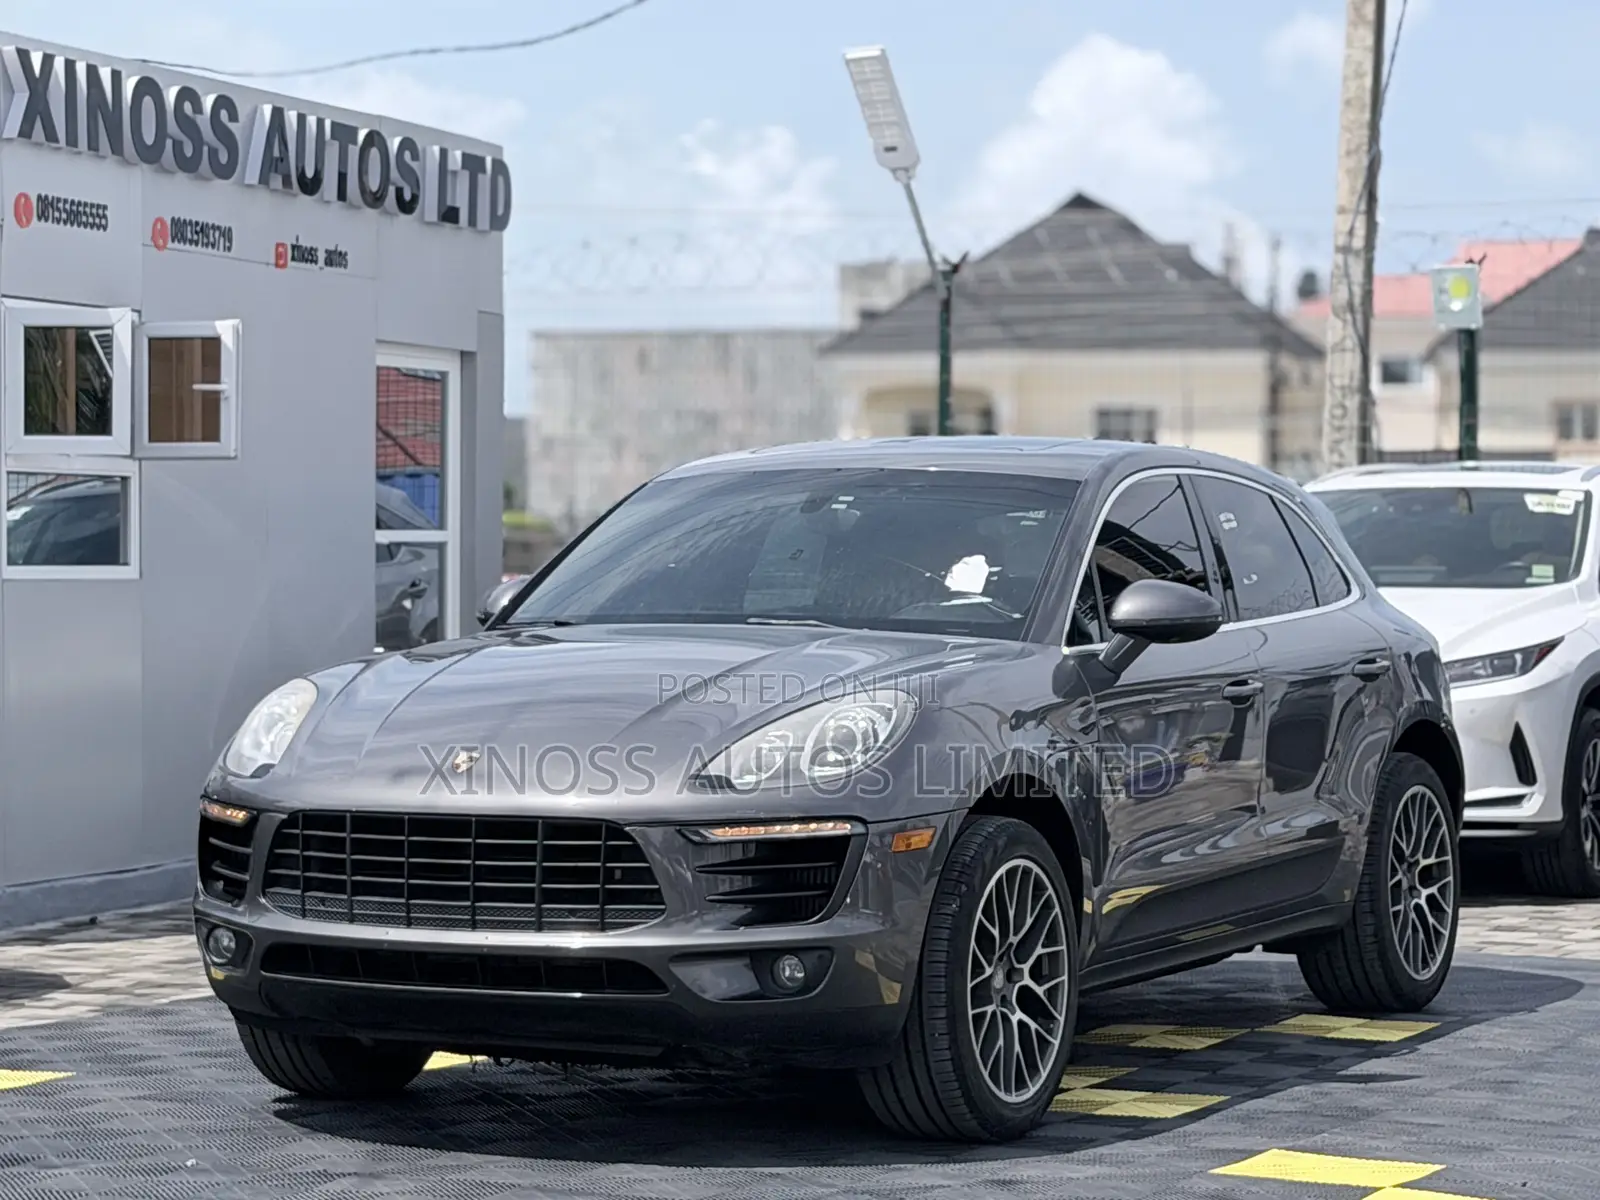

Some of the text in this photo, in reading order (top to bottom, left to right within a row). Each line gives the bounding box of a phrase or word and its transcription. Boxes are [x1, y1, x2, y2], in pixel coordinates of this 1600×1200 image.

[14, 46, 512, 232] XINOSS AUTOS LTD
